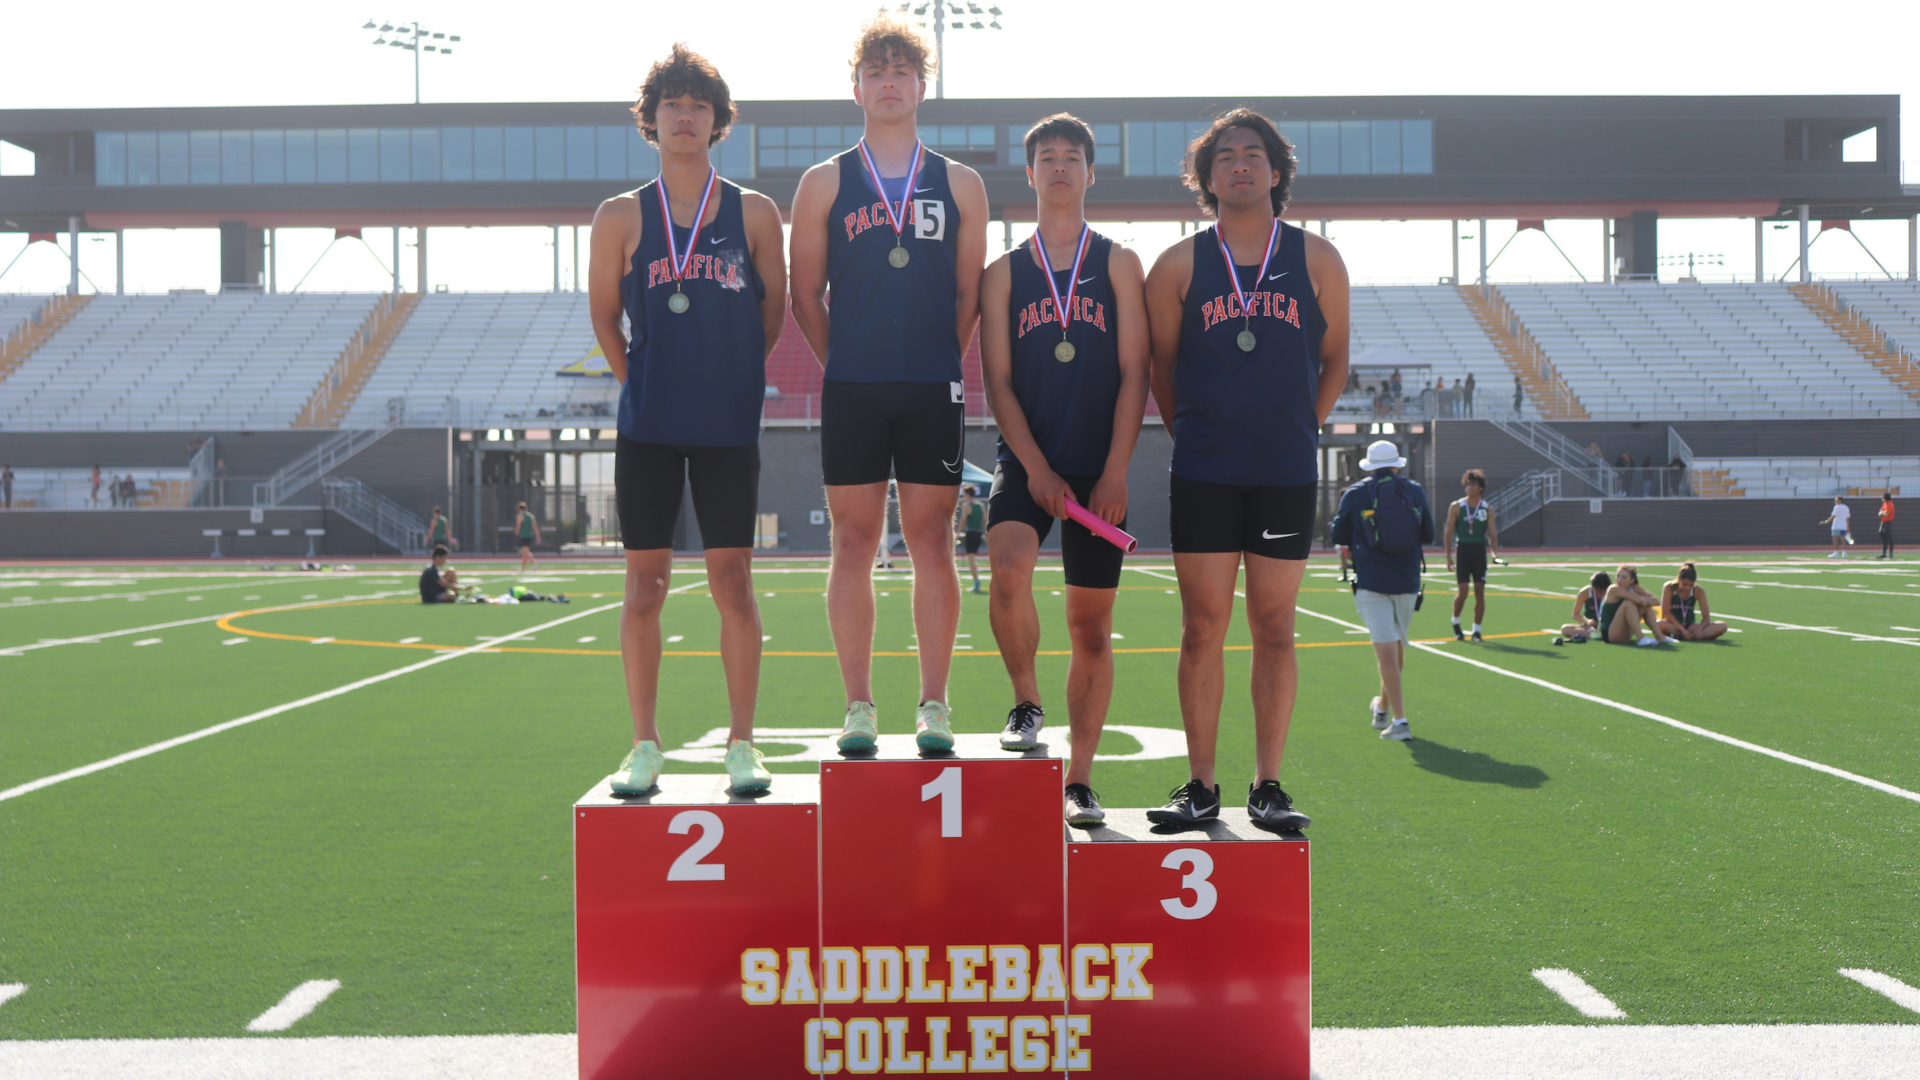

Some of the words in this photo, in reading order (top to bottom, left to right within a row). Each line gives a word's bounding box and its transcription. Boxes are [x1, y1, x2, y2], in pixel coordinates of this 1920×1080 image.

[844, 200, 916, 242] PACI
[922, 202, 940, 238] 5
[648, 254, 740, 292] PAIFICA
[1018, 295, 1106, 339] PACICA
[921, 767, 962, 837] 1
[667, 810, 725, 881] 2
[1160, 848, 1217, 920] 3
[741, 943, 1153, 1005] SADDLEBACK
[804, 1014, 1092, 1074] COLLEGE
